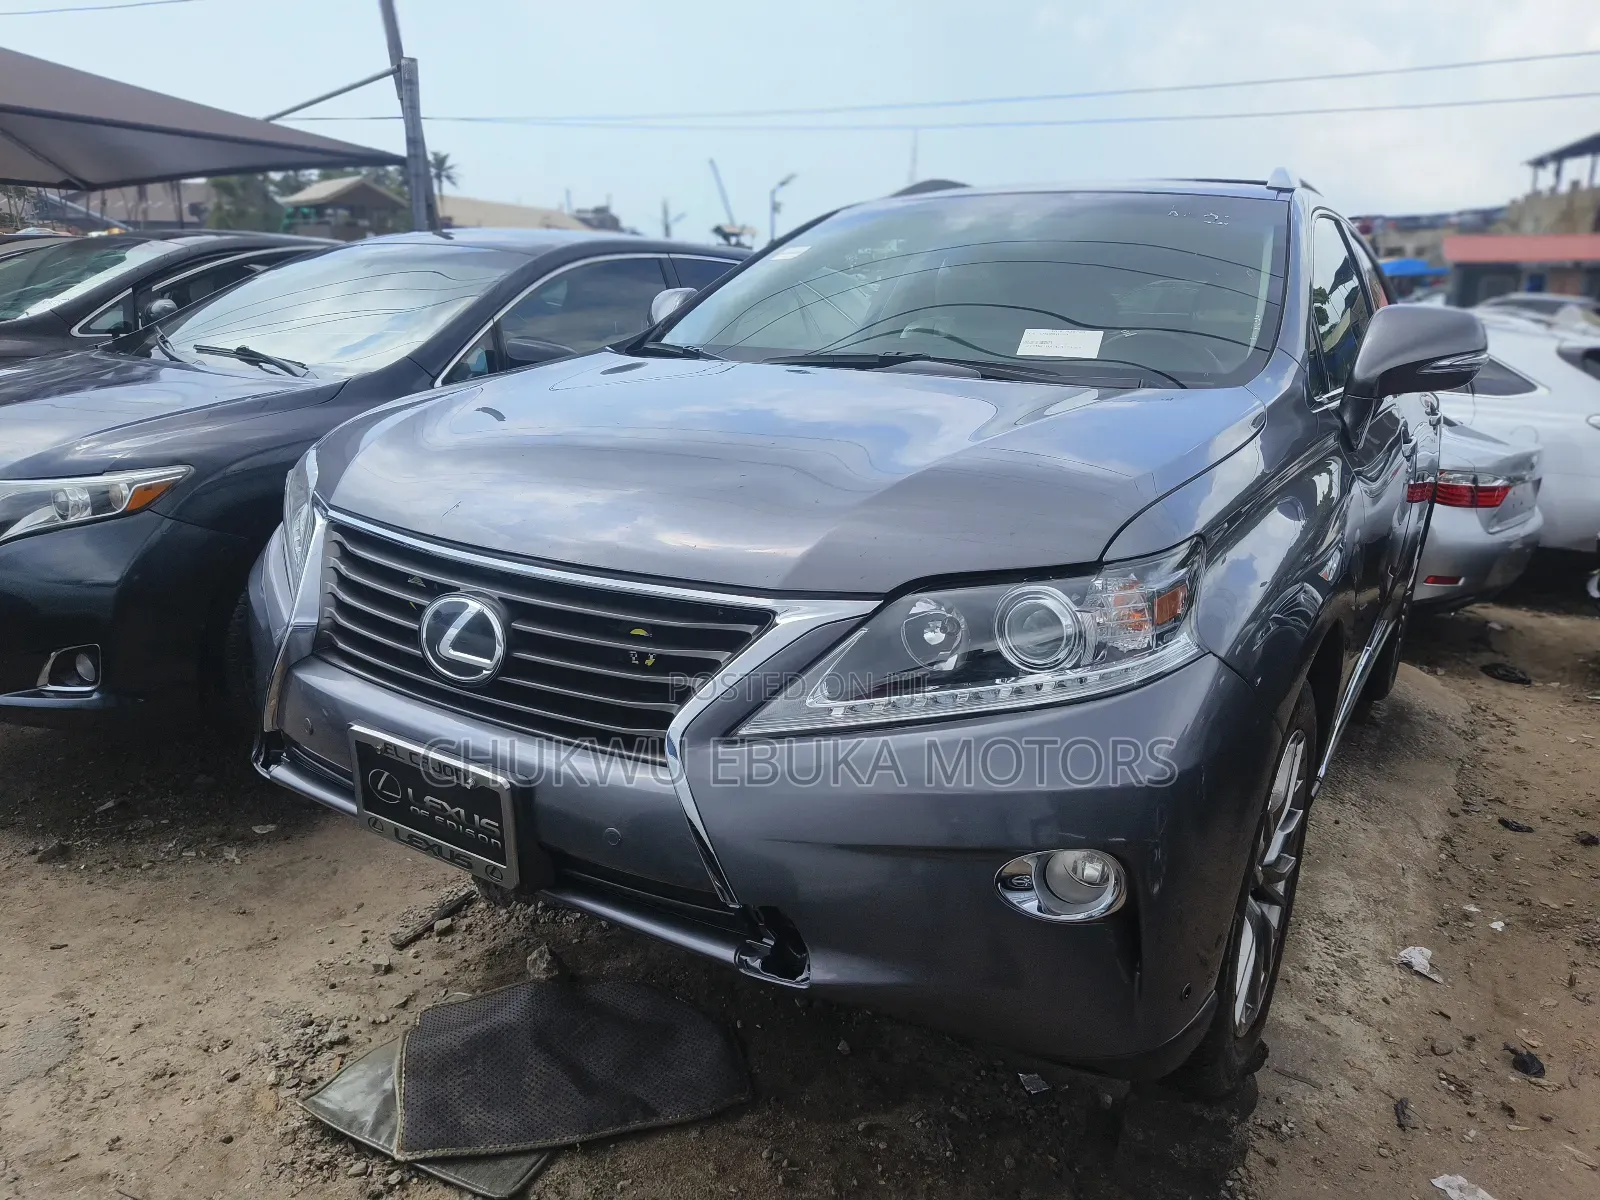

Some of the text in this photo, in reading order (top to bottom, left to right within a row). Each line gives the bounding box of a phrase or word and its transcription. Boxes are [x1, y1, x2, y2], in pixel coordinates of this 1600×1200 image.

[383, 741, 405, 760] EL
[407, 787, 502, 838] LEXUS
[410, 805, 430, 820] OF
[393, 827, 474, 871] LEXUS
